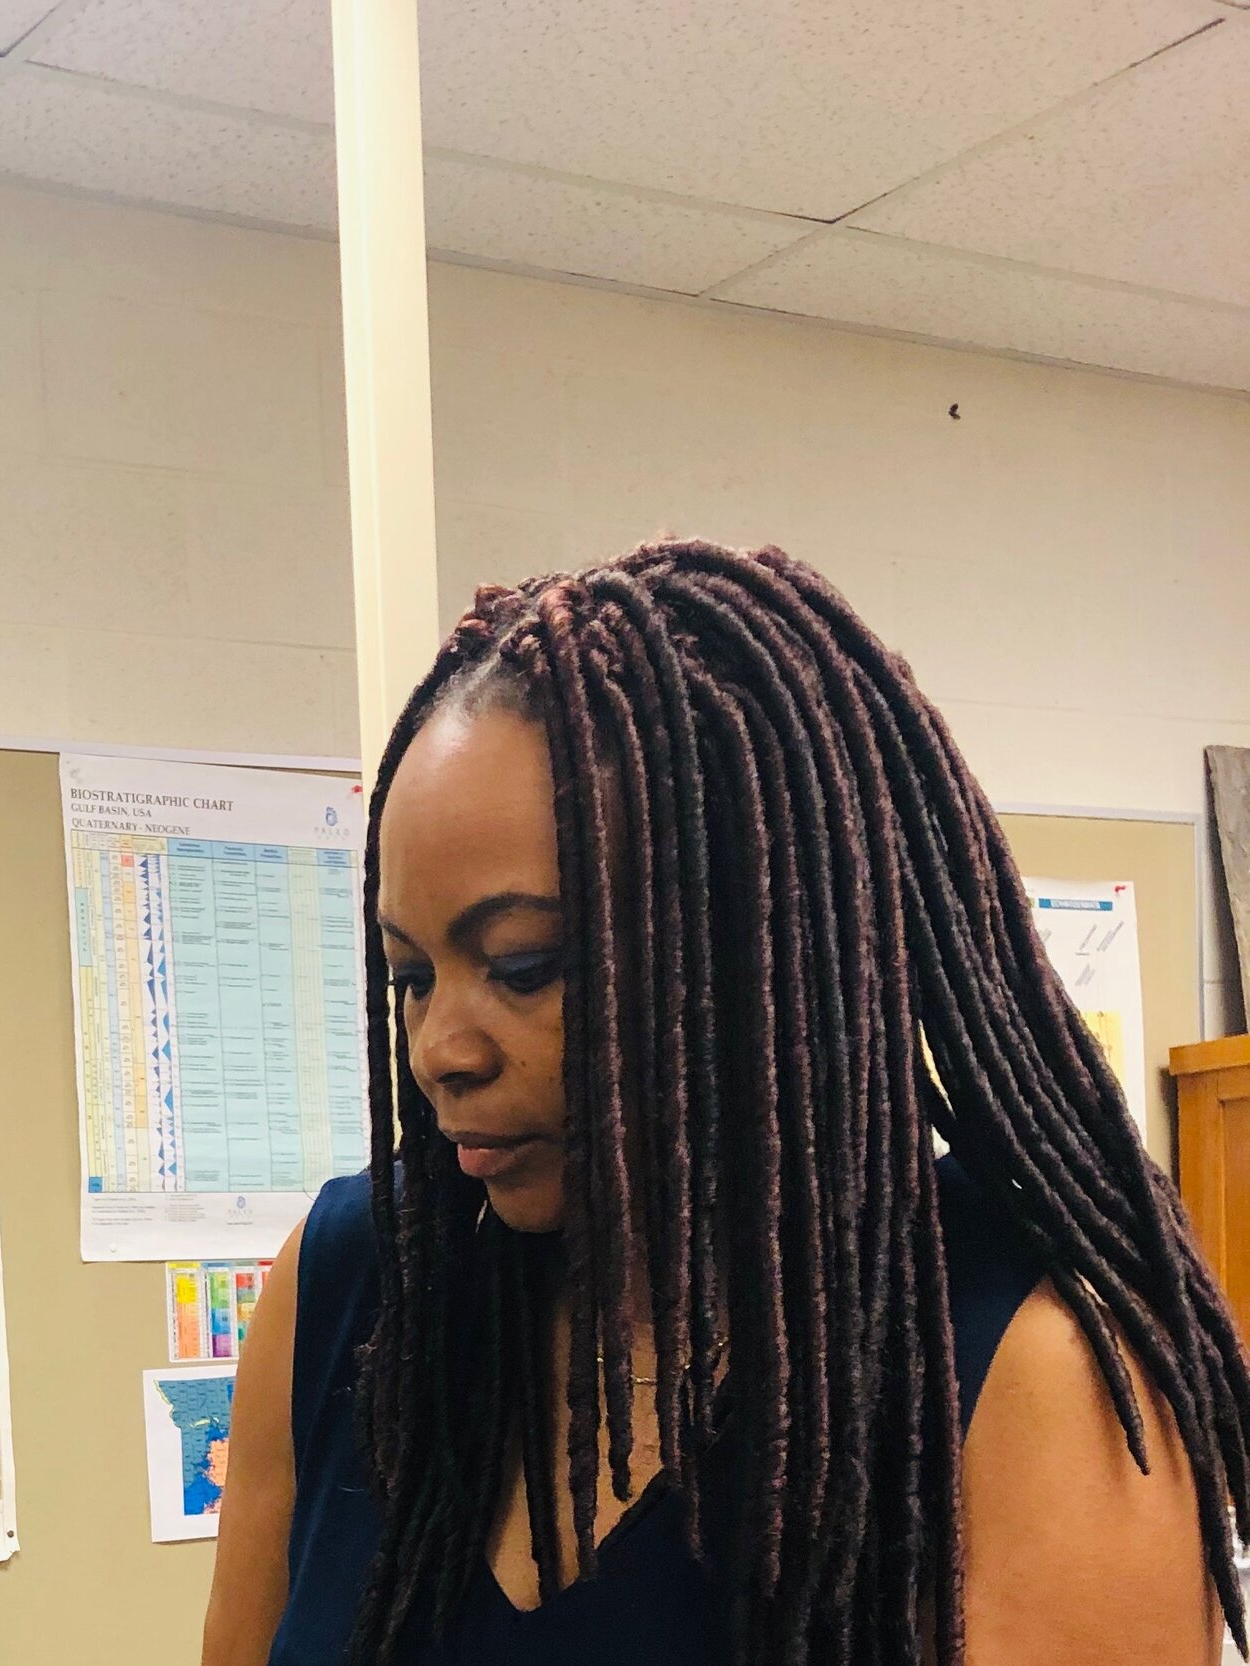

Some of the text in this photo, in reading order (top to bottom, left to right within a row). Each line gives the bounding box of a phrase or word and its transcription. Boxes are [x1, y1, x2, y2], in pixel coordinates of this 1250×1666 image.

[70, 788, 234, 812] BIOSTRATIGRAPHIC CHART
[71, 803, 96, 814] GULF
[133, 808, 152, 818] USA
[72, 818, 138, 832] QUATERNARY
[145, 824, 191, 835] NEOGENE
